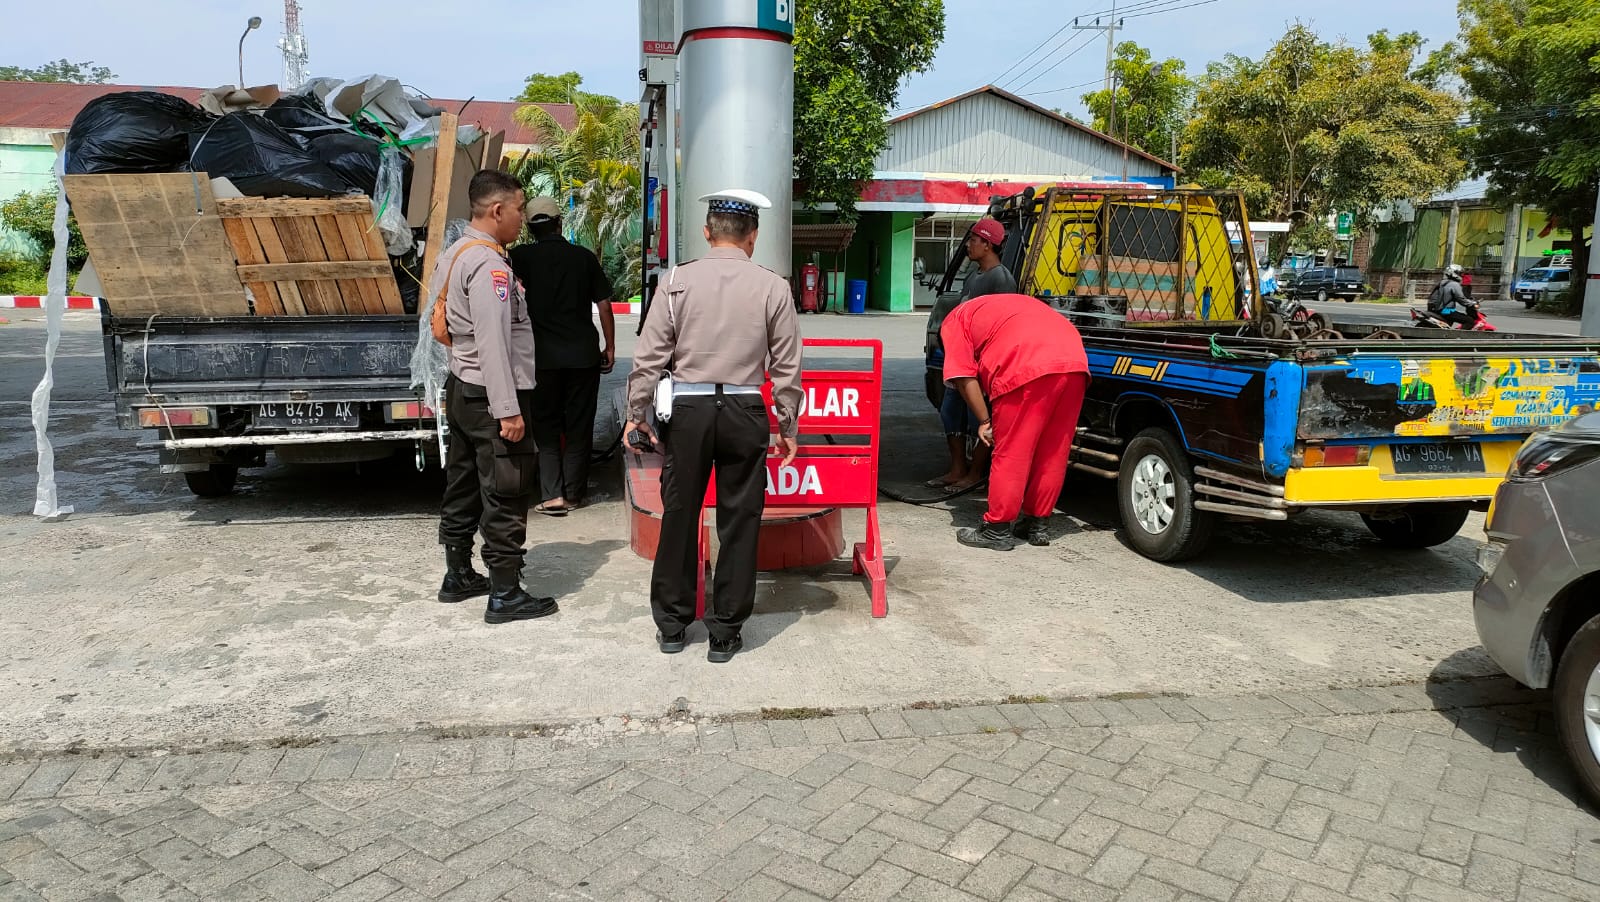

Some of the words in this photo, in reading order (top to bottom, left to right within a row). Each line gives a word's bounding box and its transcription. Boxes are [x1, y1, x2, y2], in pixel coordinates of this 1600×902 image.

[259, 403, 276, 417] AG
[286, 402, 324, 417] 8475
[335, 402, 352, 417] AK
[771, 388, 860, 417] LAR
[1395, 445, 1411, 462] AG
[1420, 445, 1453, 462] 9664
[1463, 444, 1481, 462] VA
